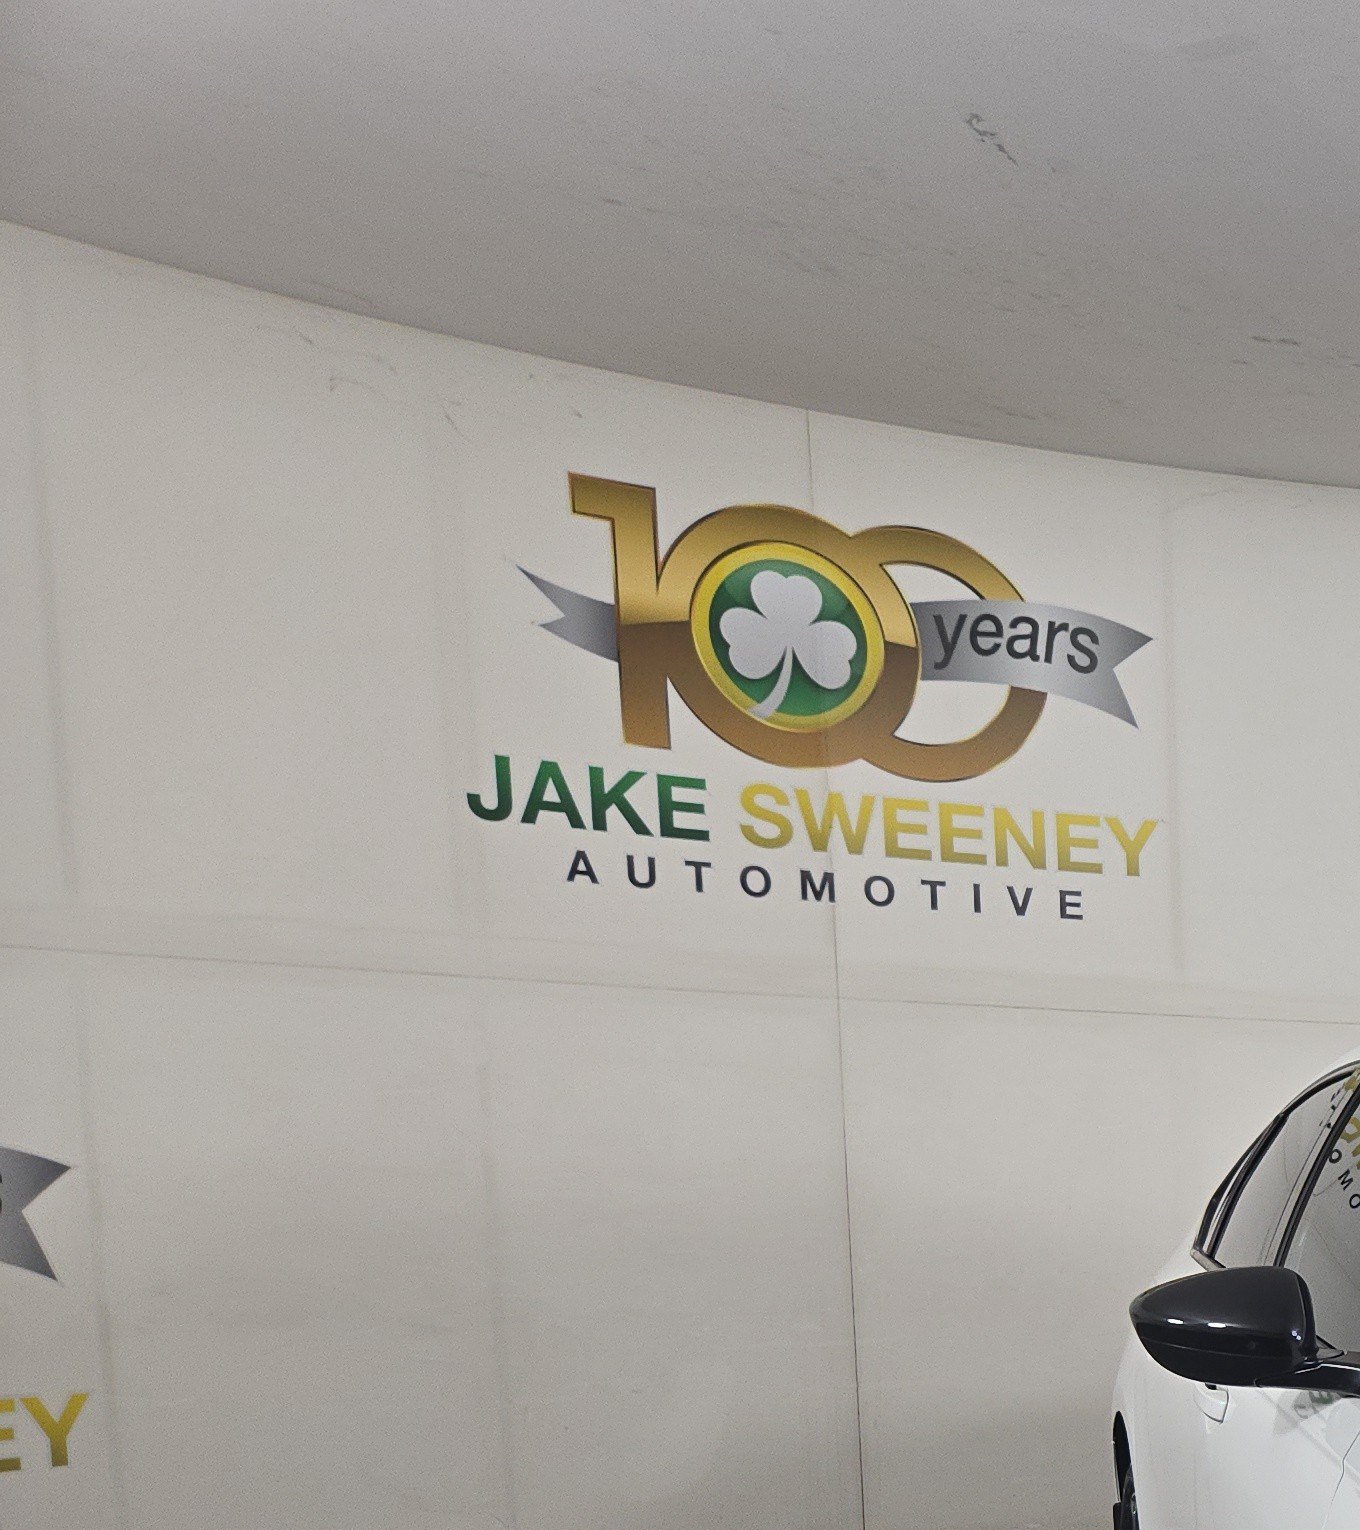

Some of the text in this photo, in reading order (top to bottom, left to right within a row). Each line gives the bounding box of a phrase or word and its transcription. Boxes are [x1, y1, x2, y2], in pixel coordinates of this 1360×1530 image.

[933, 610, 1101, 674] years
[466, 755, 1158, 877] JAKE SWEENEY
[566, 850, 1084, 921] AUTOMOTIVE
